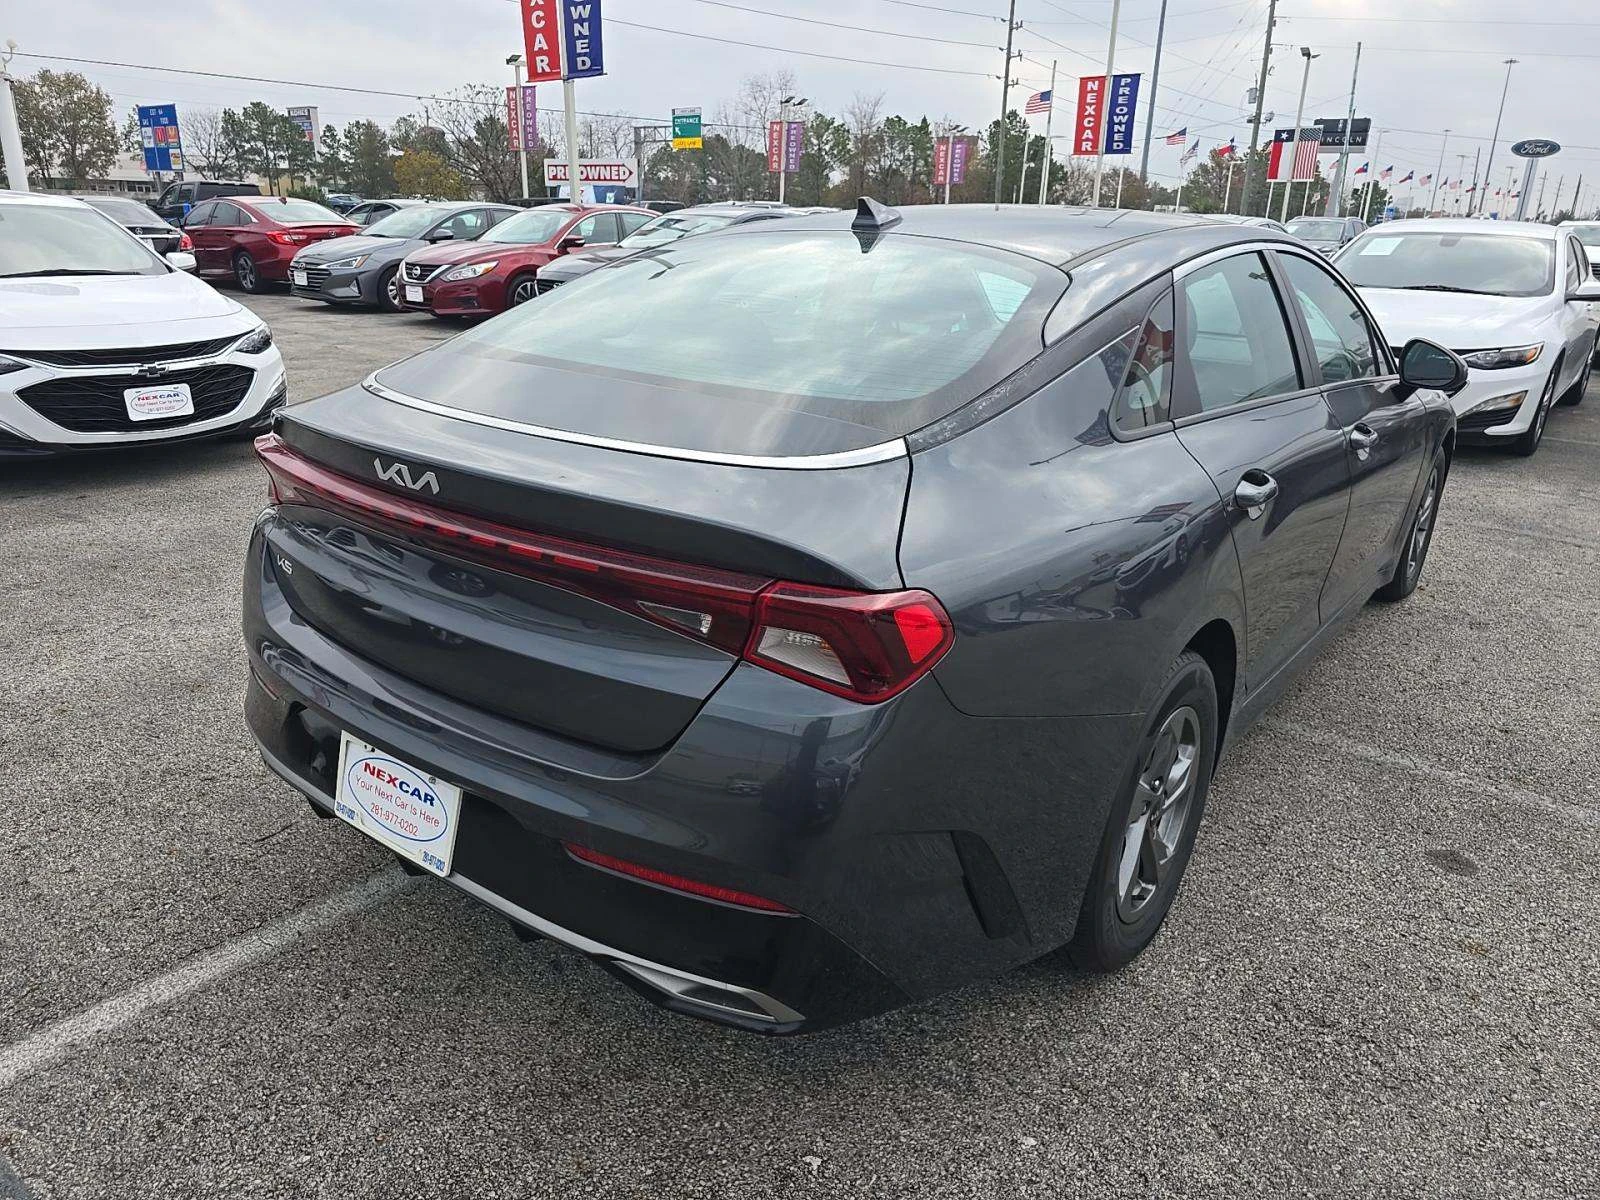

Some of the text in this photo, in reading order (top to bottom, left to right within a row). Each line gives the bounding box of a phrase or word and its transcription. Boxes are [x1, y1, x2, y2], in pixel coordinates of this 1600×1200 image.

[571, 0, 592, 70] WNED
[509, 90, 519, 147] NEXCAR
[525, 89, 534, 147] PREOWNED
[1081, 81, 1099, 151] NEXCAR
[1113, 78, 1132, 149] PREOWNED
[772, 124, 781, 170] NEXCAR
[788, 124, 798, 170] PREOWNED
[938, 144, 947, 182] NEXCAR
[1520, 143, 1550, 154] Ford
[137, 393, 180, 401] NEXCAR
[373, 457, 440, 495] KIA
[356, 774, 440, 828] Your Next Car Is Here
[363, 761, 435, 807] NEXCAR
[370, 802, 420, 836] 281-977-0202
